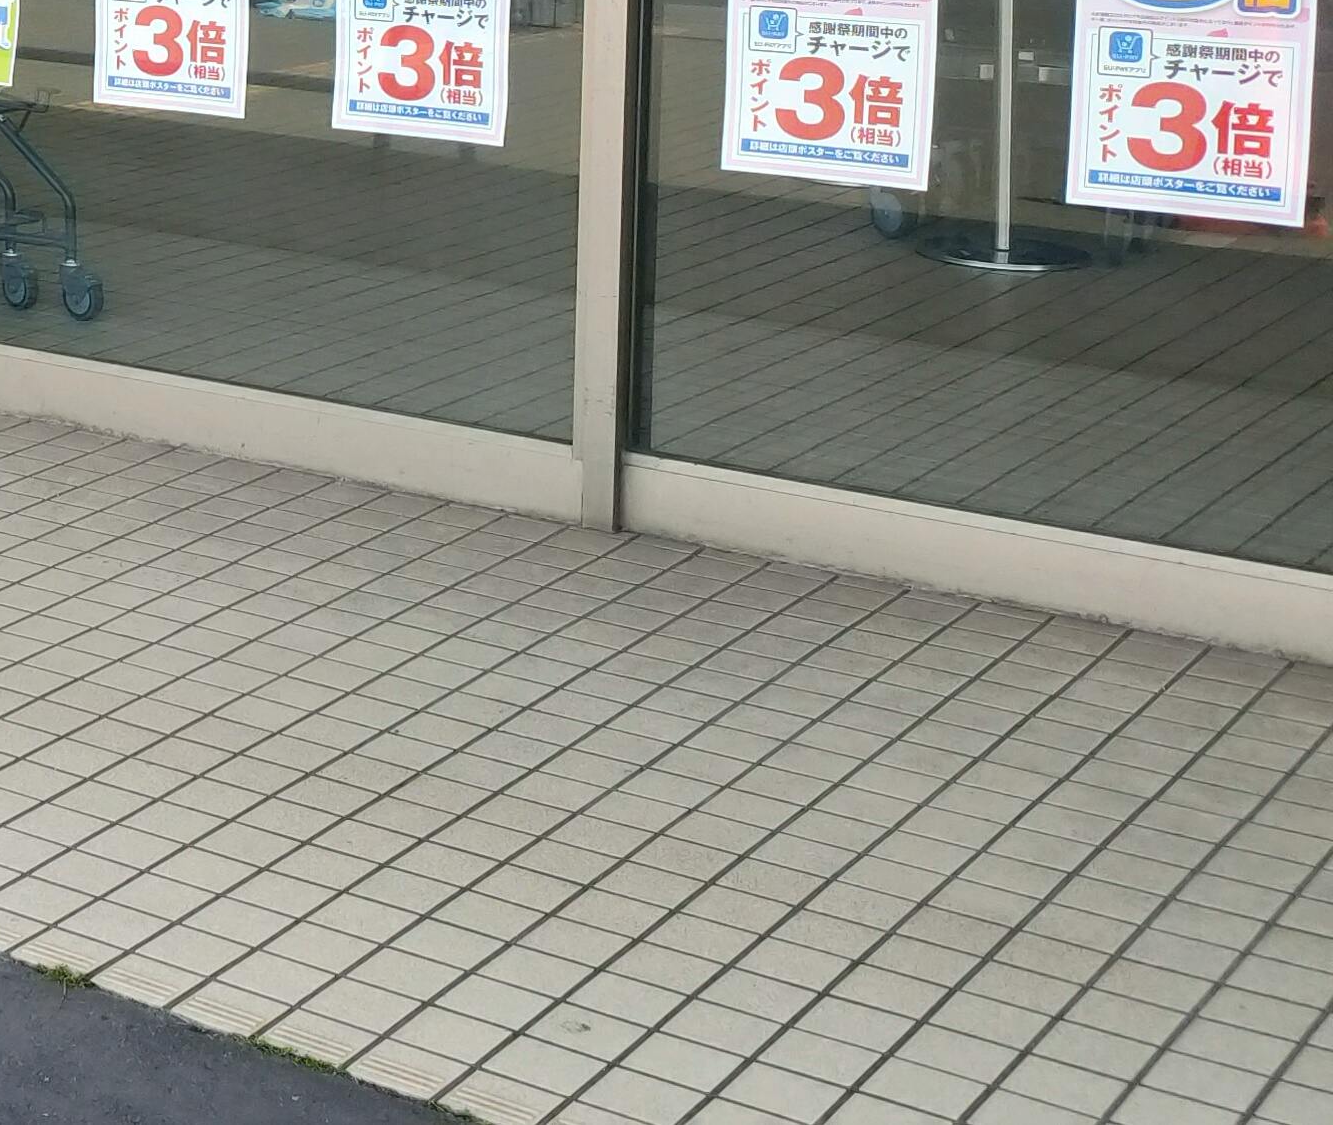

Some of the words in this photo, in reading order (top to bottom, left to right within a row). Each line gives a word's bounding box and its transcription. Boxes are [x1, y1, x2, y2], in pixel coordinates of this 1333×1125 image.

[113, 7, 128, 70] ポイント
[132, 5, 226, 76] 3倍
[402, 6, 489, 28] チャージで
[806, 35, 911, 62] チャージで
[808, 21, 908, 40] 感謝祭期間中の
[356, 27, 373, 94] ポイント
[377, 24, 484, 101] 3倍
[1164, 59, 1283, 89] チャージで
[1165, 43, 1280, 64] 感謝祭期間中の
[750, 59, 771, 132] ポイント
[775, 56, 904, 141] 3倍
[1100, 84, 1122, 162] ポイント
[1127, 81, 1274, 171] 3倍
